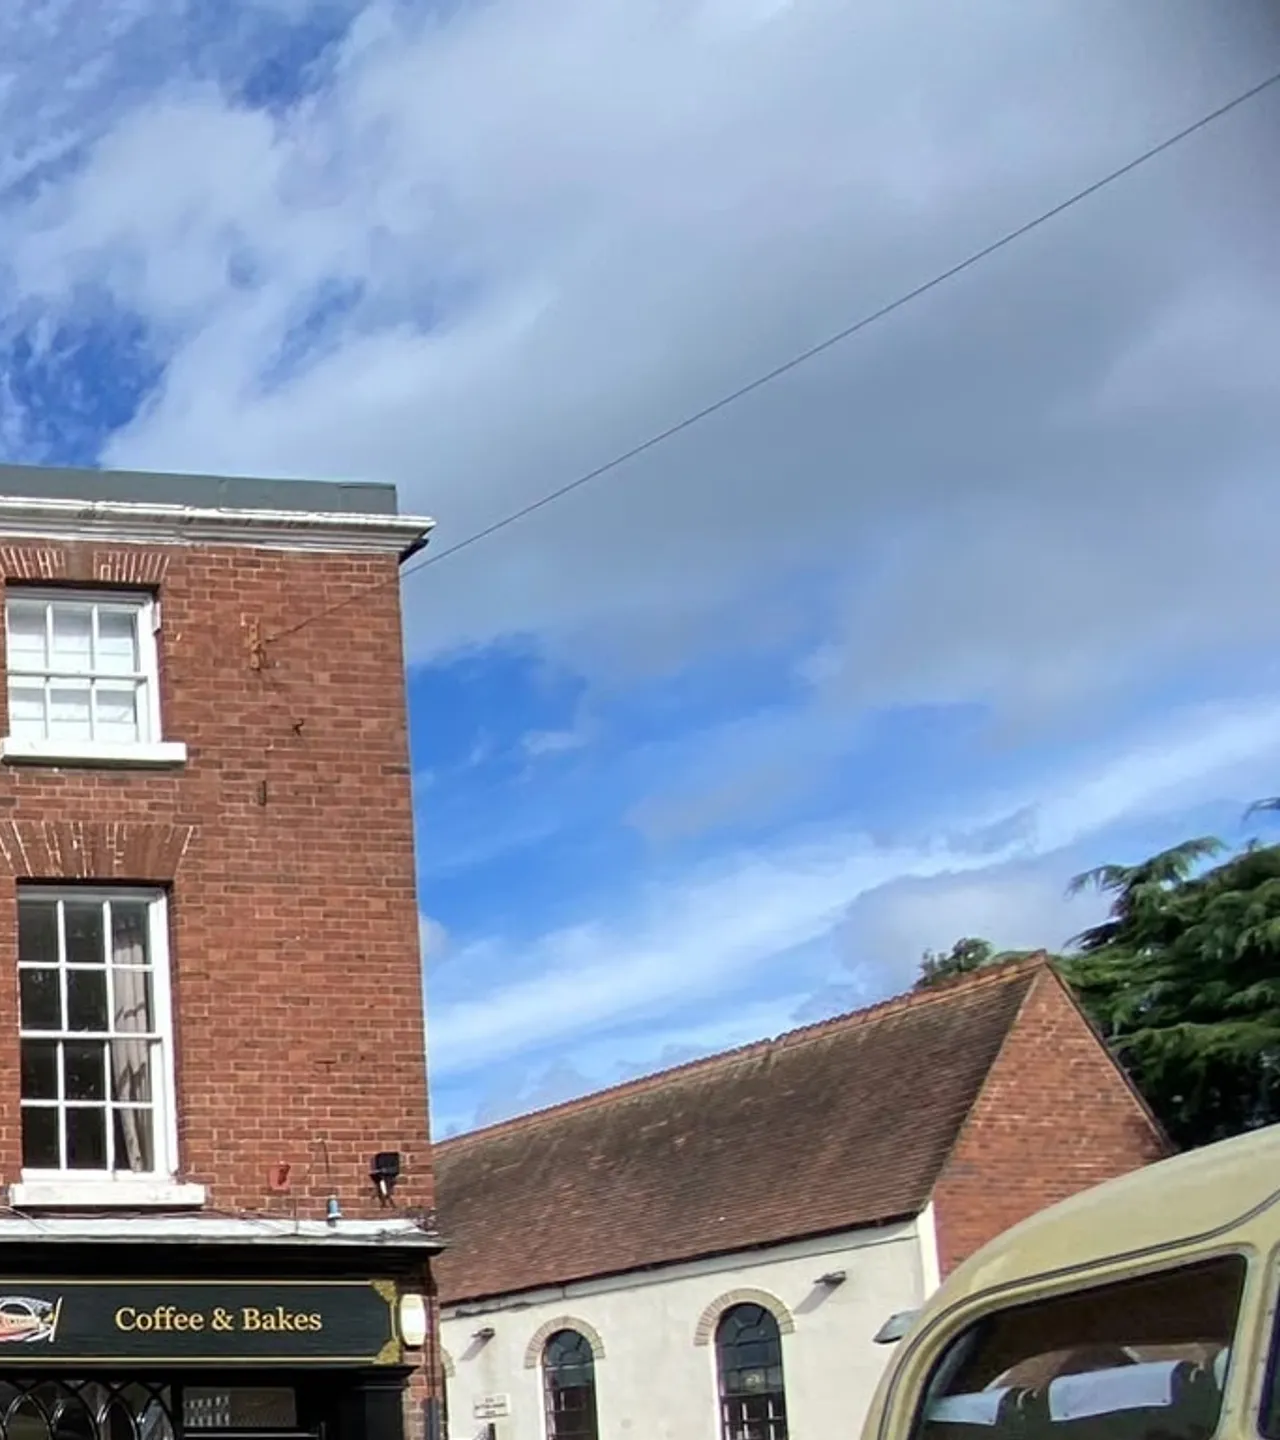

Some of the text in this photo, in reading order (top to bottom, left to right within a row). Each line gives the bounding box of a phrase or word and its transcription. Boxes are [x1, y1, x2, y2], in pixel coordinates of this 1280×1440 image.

[115, 1306, 323, 1331] Coffee & Bakes
